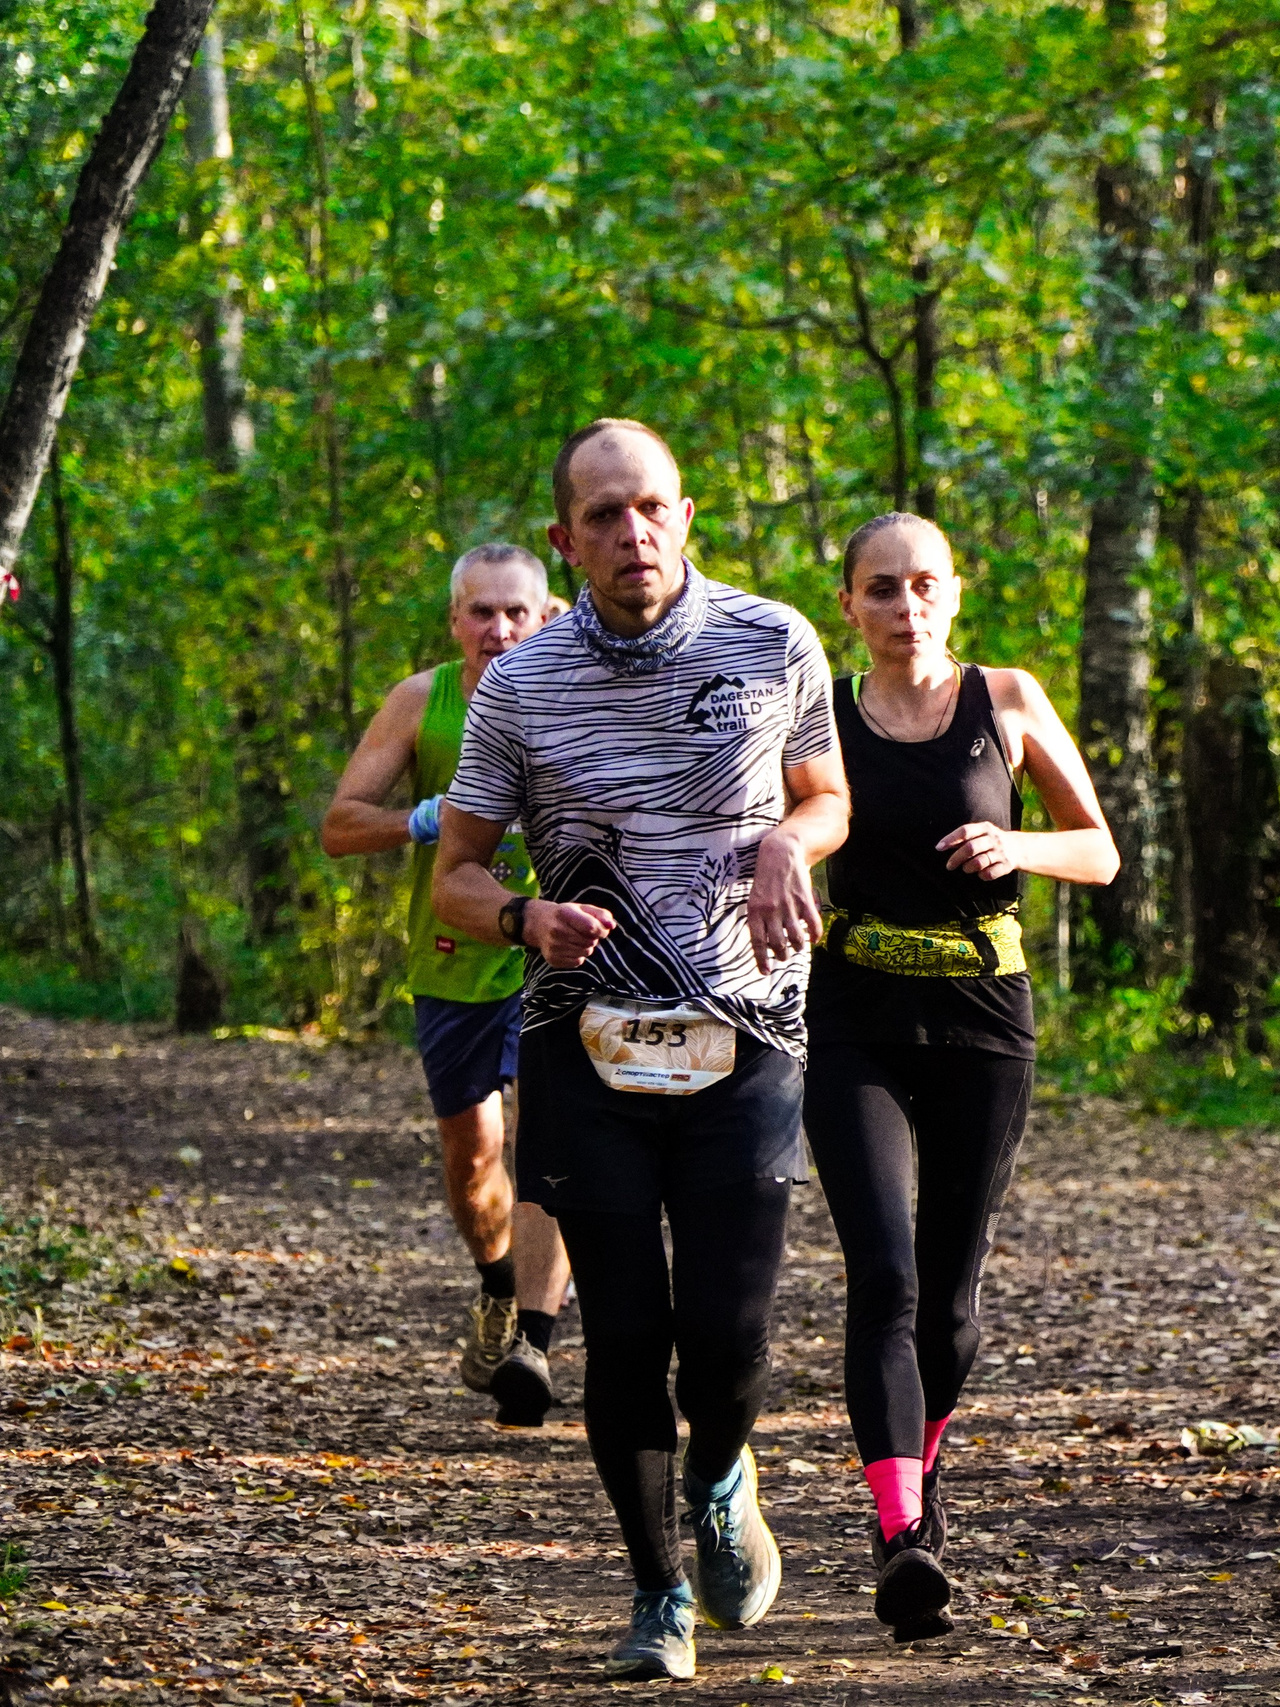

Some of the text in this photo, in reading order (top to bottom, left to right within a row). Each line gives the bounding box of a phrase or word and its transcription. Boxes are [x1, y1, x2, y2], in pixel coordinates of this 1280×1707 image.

[710, 688, 774, 704] DAGESTAN
[711, 701, 762, 719] WILD
[716, 718, 747, 733] trail
[623, 1019, 687, 1048] 153
